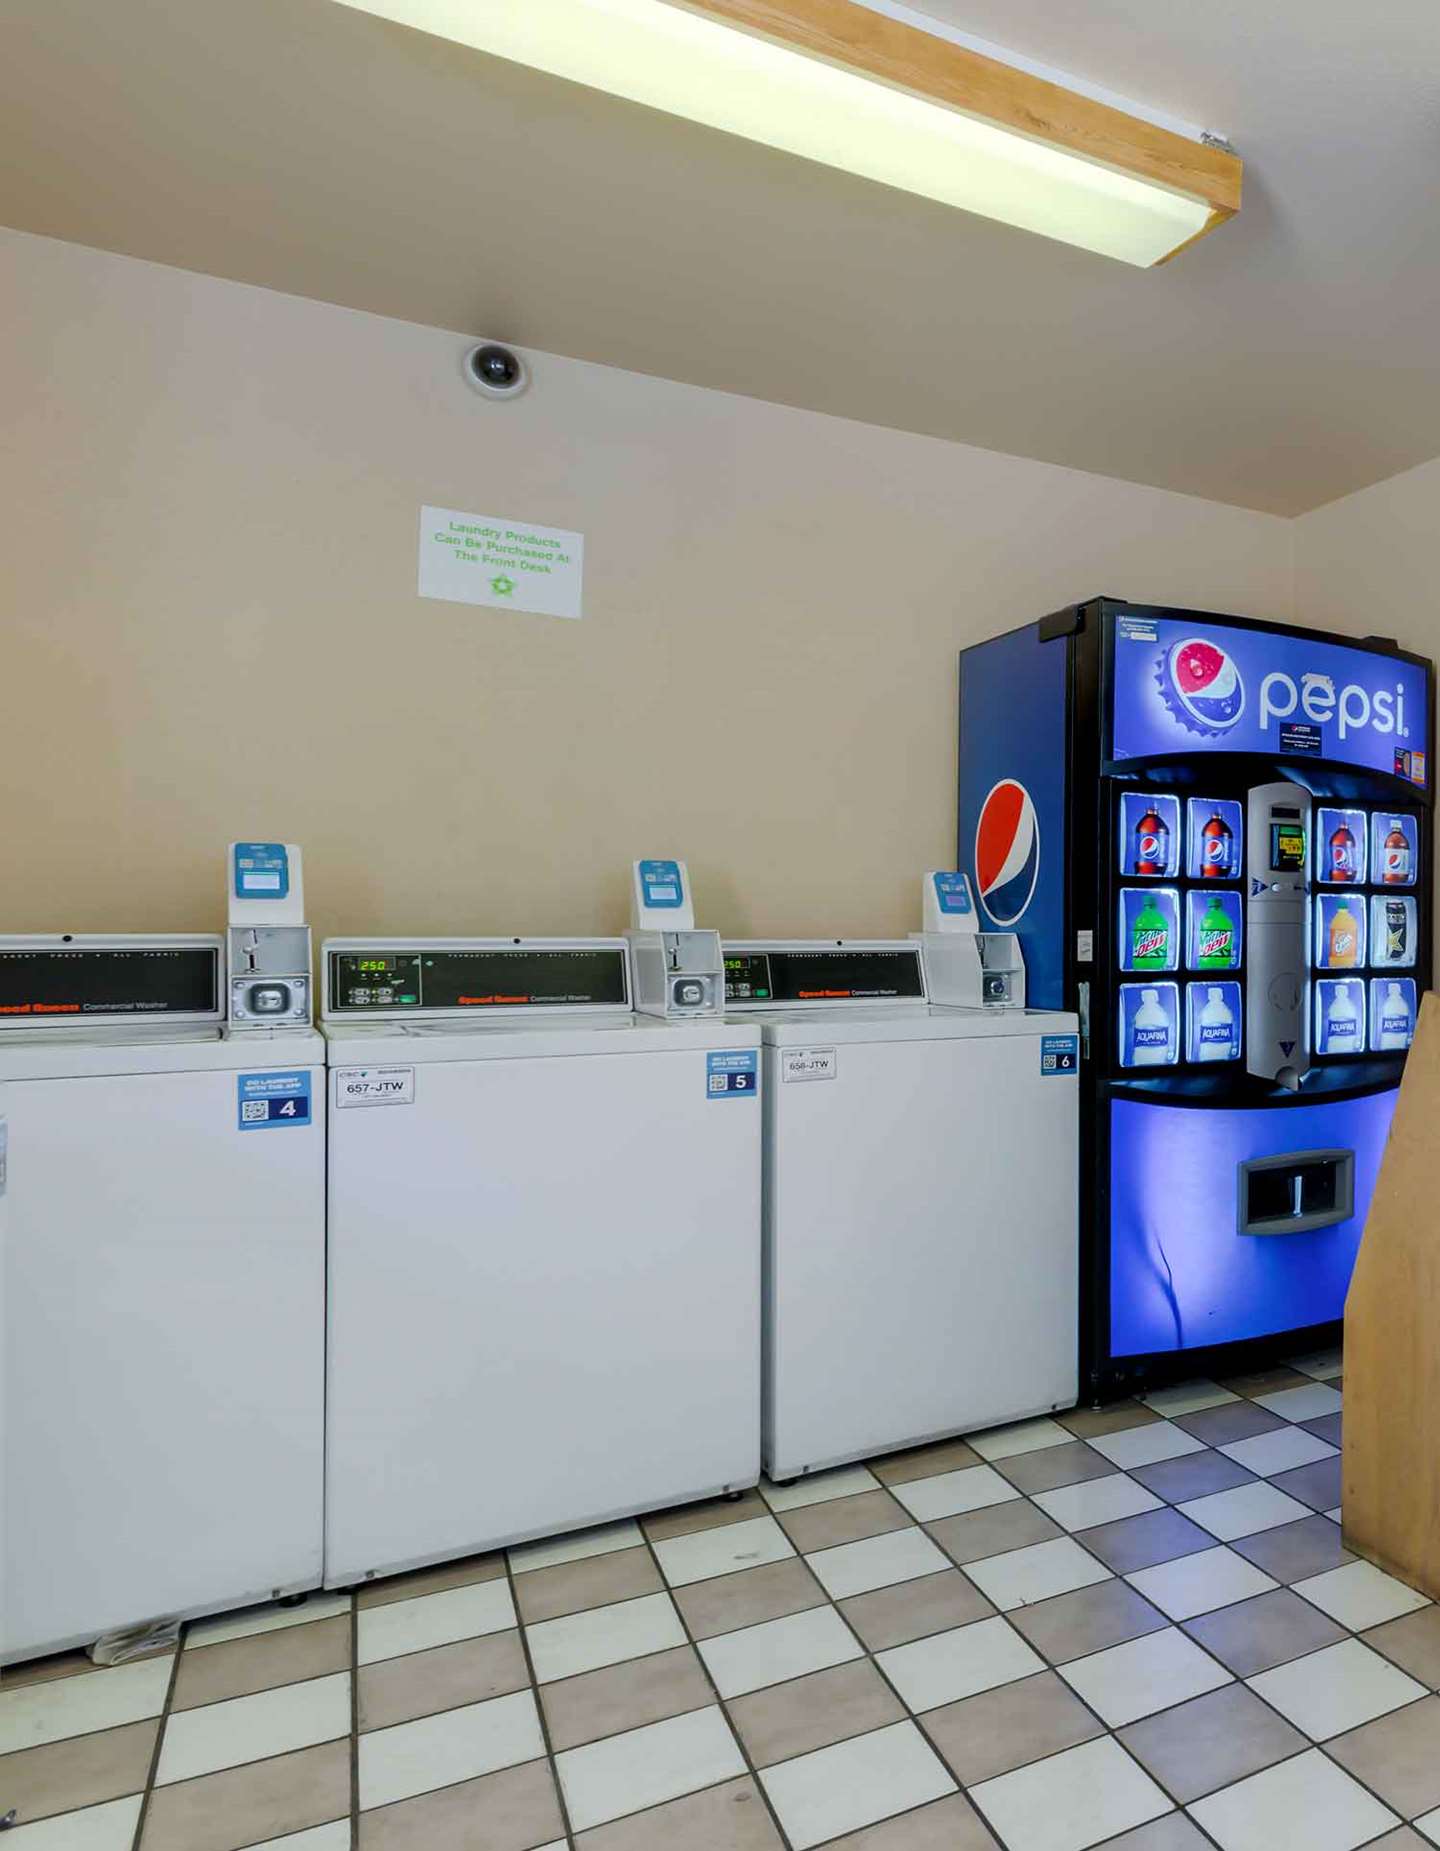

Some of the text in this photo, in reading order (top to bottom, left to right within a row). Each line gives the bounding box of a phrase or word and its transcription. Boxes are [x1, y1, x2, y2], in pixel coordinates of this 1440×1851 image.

[449, 521, 561, 549] Laundry Products
[434, 532, 570, 564] Can Be Purchased At
[454, 550, 552, 574] The Front Desk
[1260, 672, 1404, 739] pepsi
[361, 961, 385, 971] 250
[83, 1003, 134, 1011] Commercial
[136, 1001, 168, 1009] Washer
[1137, 1031, 1167, 1041] AQUAFINA
[1203, 1028, 1230, 1038] AQUAFINA
[789, 1060, 829, 1071] 658-JTW
[1061, 1056, 1070, 1067] 6
[735, 1075, 747, 1088] 5
[346, 1082, 403, 1094] 657-JTW
[279, 1100, 296, 1116] 4
